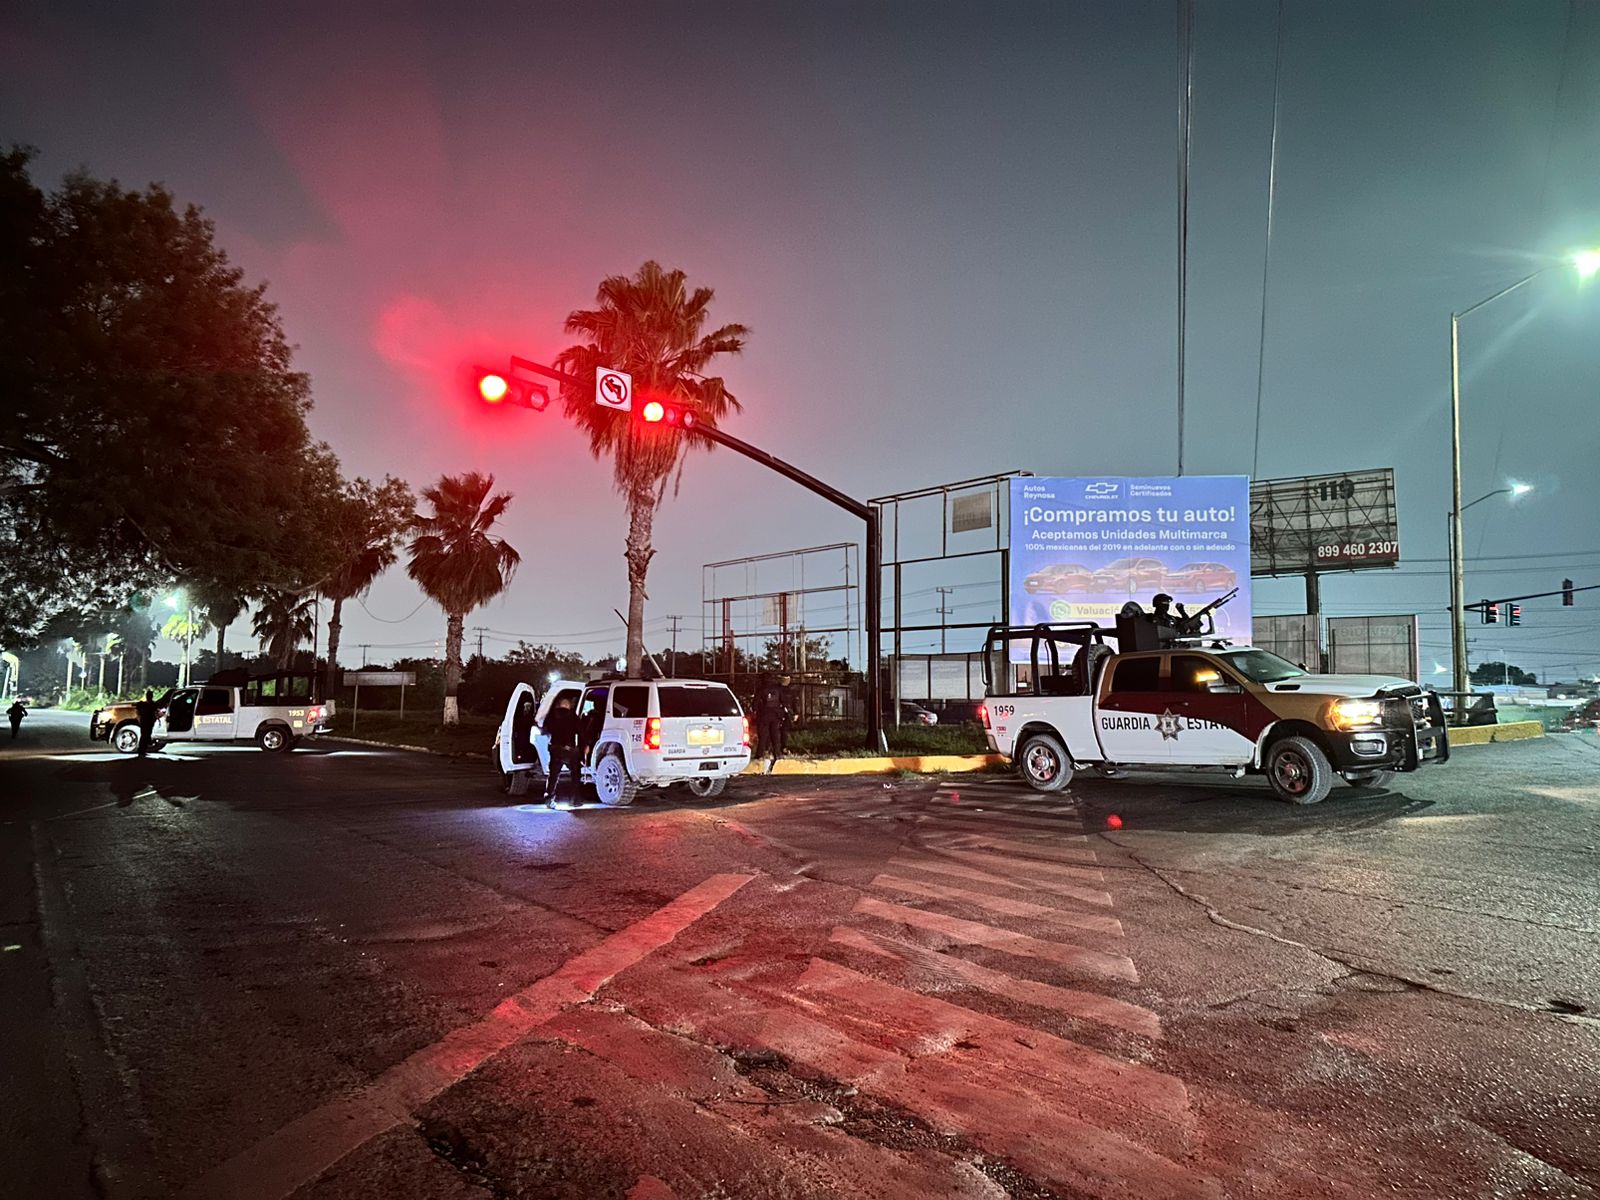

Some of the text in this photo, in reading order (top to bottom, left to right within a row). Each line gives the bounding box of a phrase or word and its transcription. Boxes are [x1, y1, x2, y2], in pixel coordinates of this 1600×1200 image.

[1024, 485, 1046, 493] Autos
[1024, 492, 1056, 500] Reynosa
[1024, 506, 1235, 525] ¡Compramos tu auto!
[1032, 529, 1228, 541] Aceptamos Unidades Multimarca
[1025, 543, 1045, 551] 100%
[1089, 543, 1101, 551] del
[1103, 543, 1121, 551] 2019
[1134, 543, 1169, 551] adelante
[1193, 543, 1205, 551] sin
[1206, 543, 1236, 551] adeudo
[1318, 541, 1397, 557] 899 460 2307
[994, 705, 1015, 717] 1959
[203, 716, 233, 724] ESTATAL
[1101, 716, 1151, 730] GUARDIA
